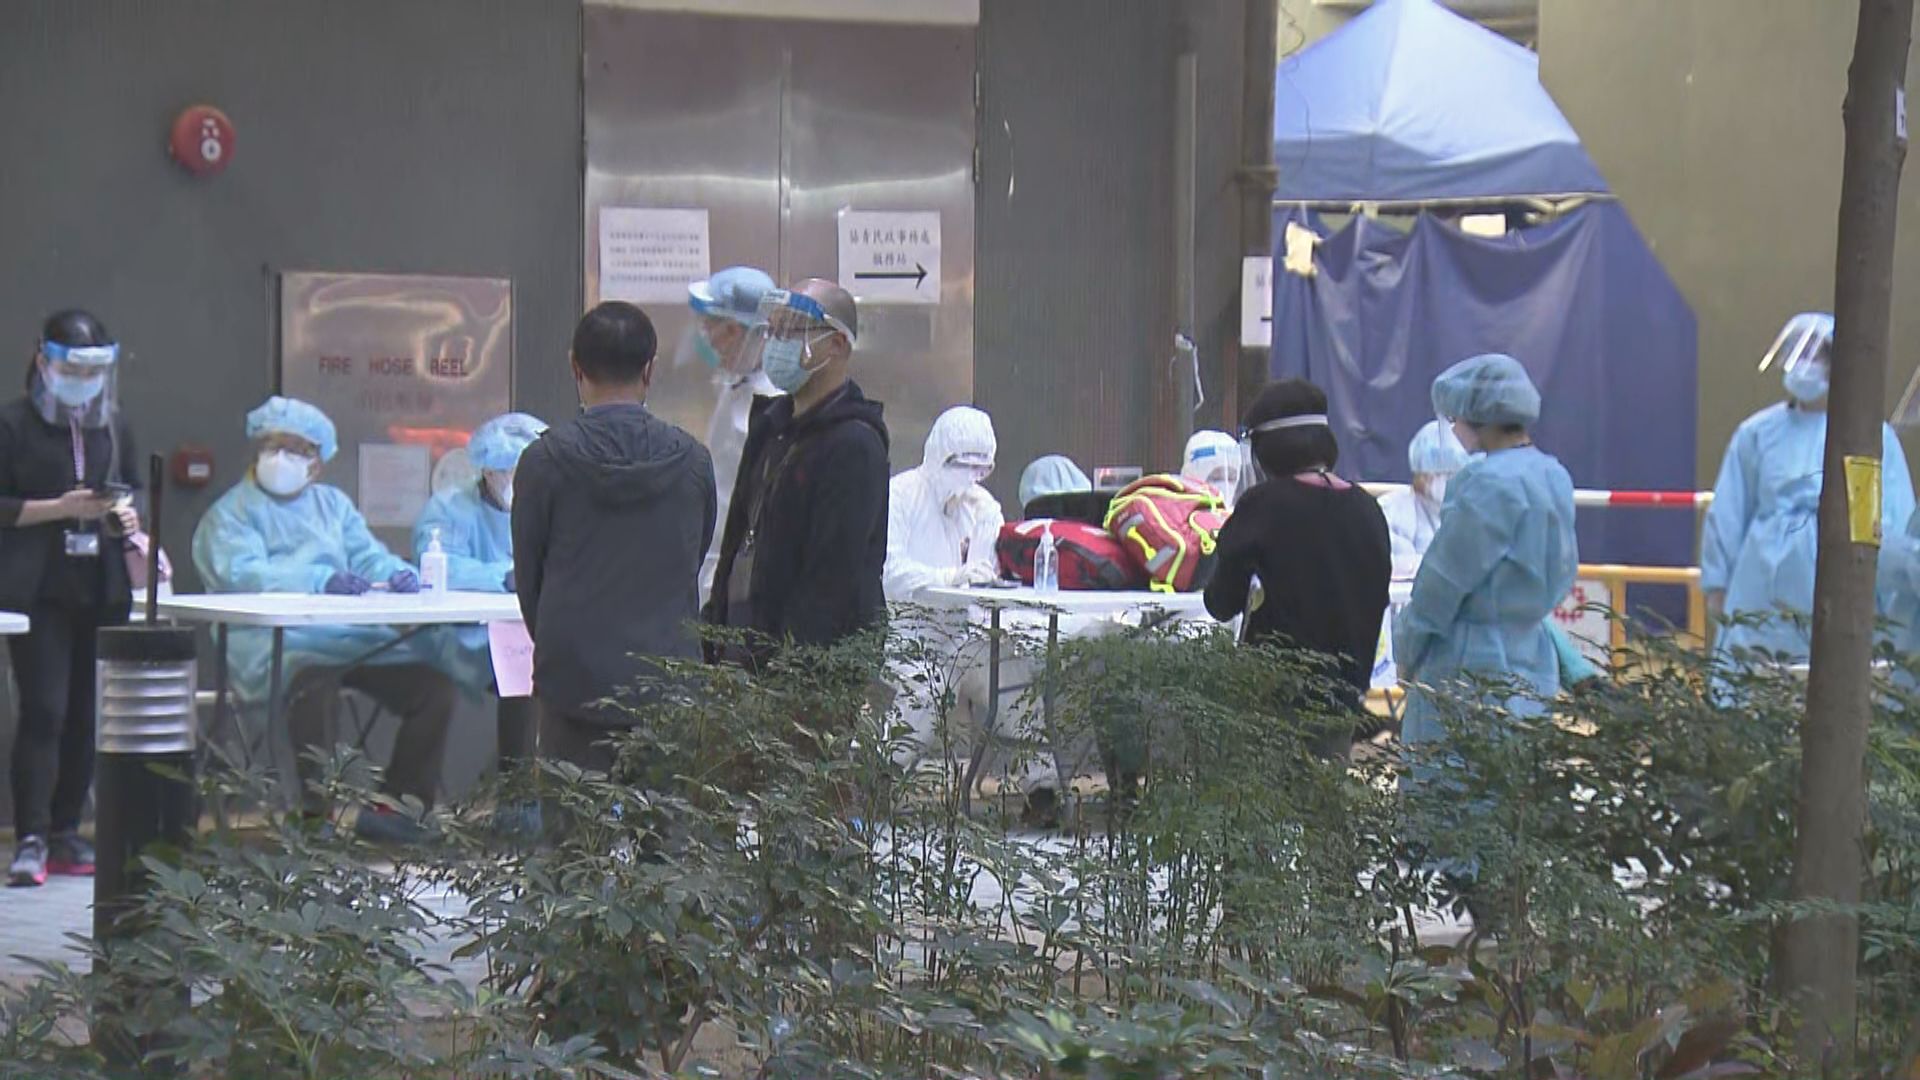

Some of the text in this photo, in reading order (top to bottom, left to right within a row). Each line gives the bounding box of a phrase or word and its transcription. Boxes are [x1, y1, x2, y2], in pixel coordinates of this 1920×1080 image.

[318, 356, 468, 377] FIRE HOSE REEL
